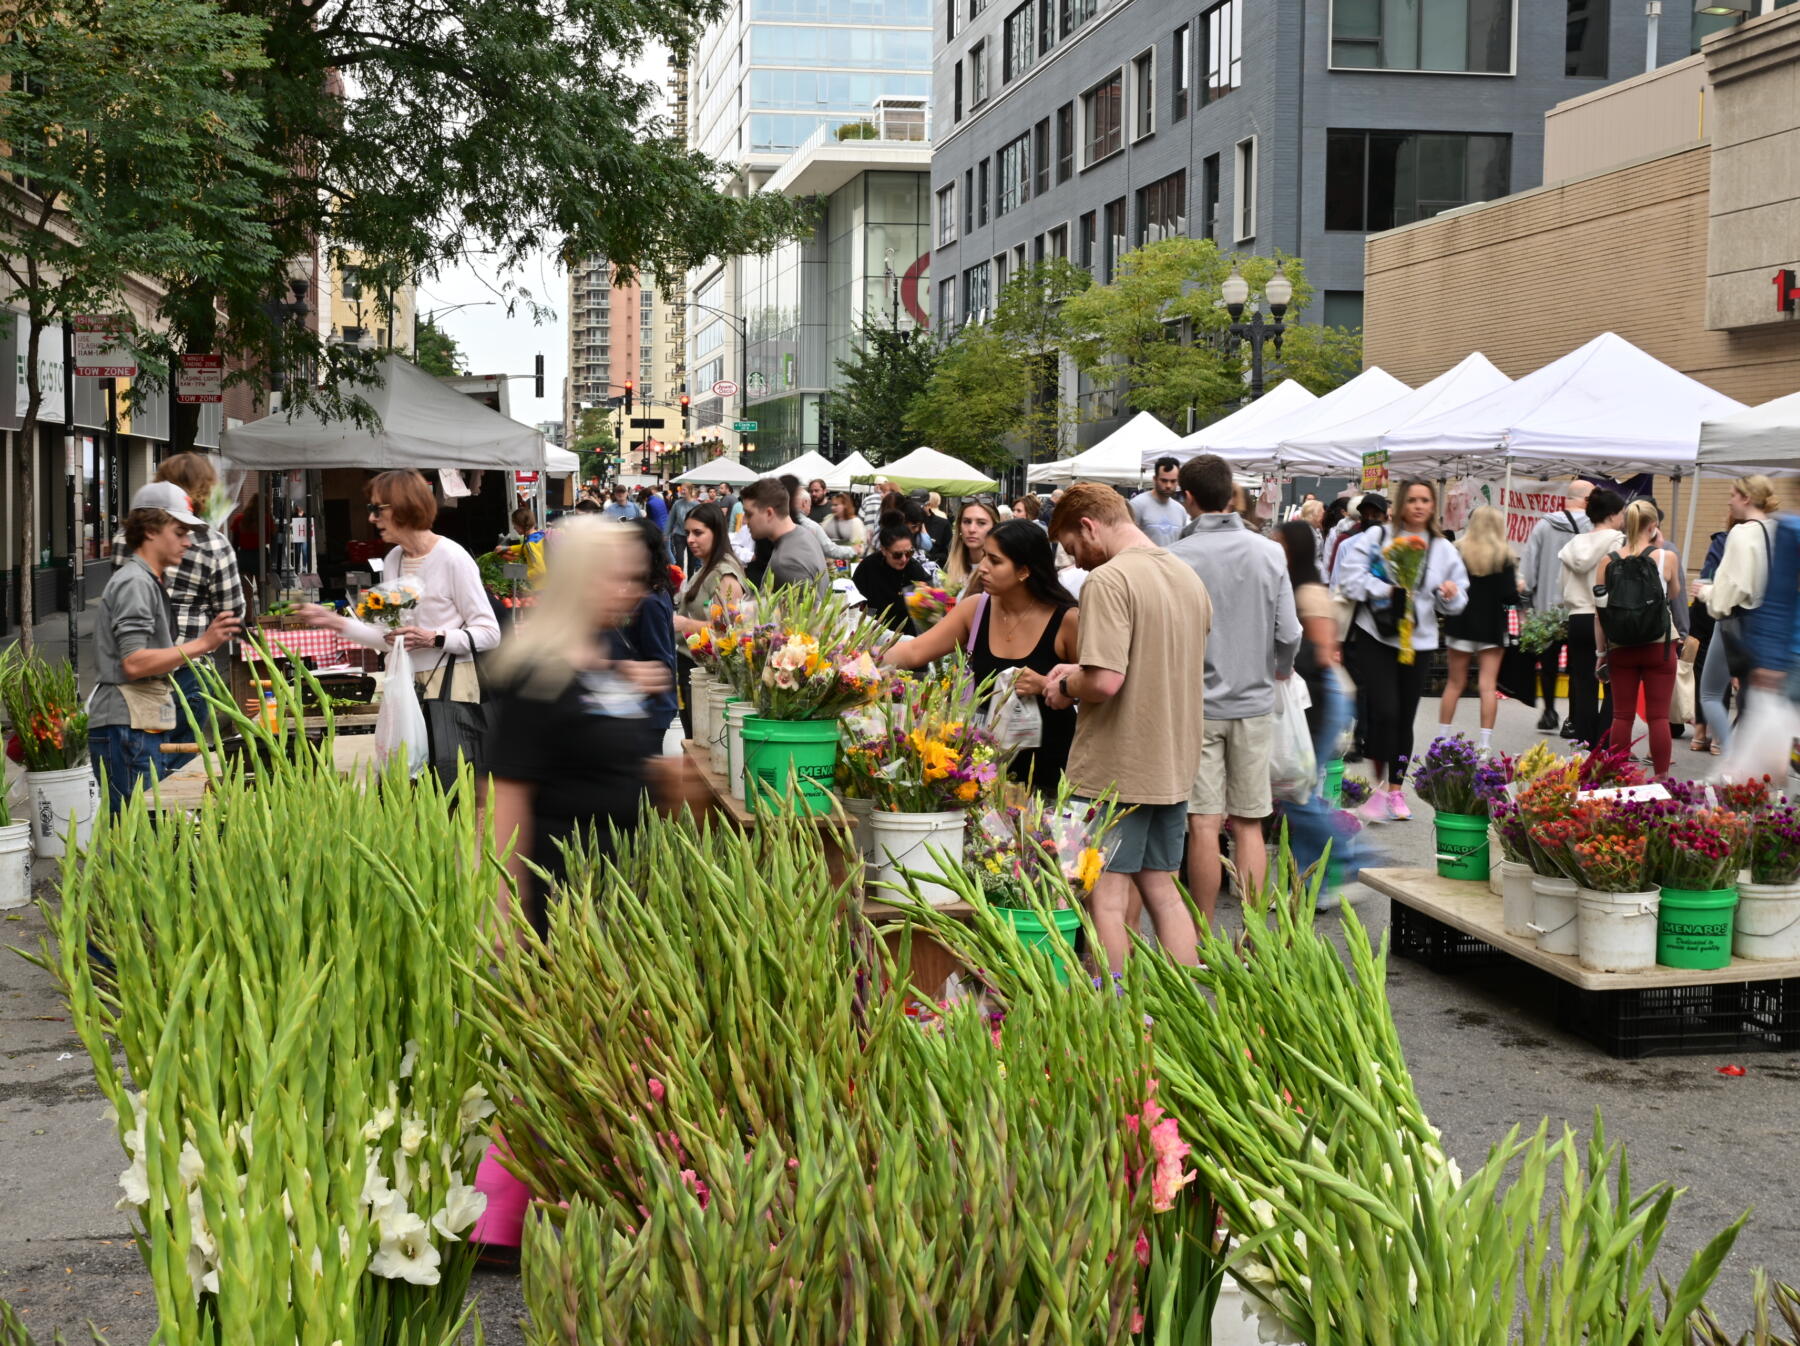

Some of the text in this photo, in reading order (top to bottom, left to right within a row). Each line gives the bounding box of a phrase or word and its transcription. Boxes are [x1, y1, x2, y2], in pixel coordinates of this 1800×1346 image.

[79, 367, 131, 376] TOW ZONE
[1527, 493, 1566, 512] FRESH
